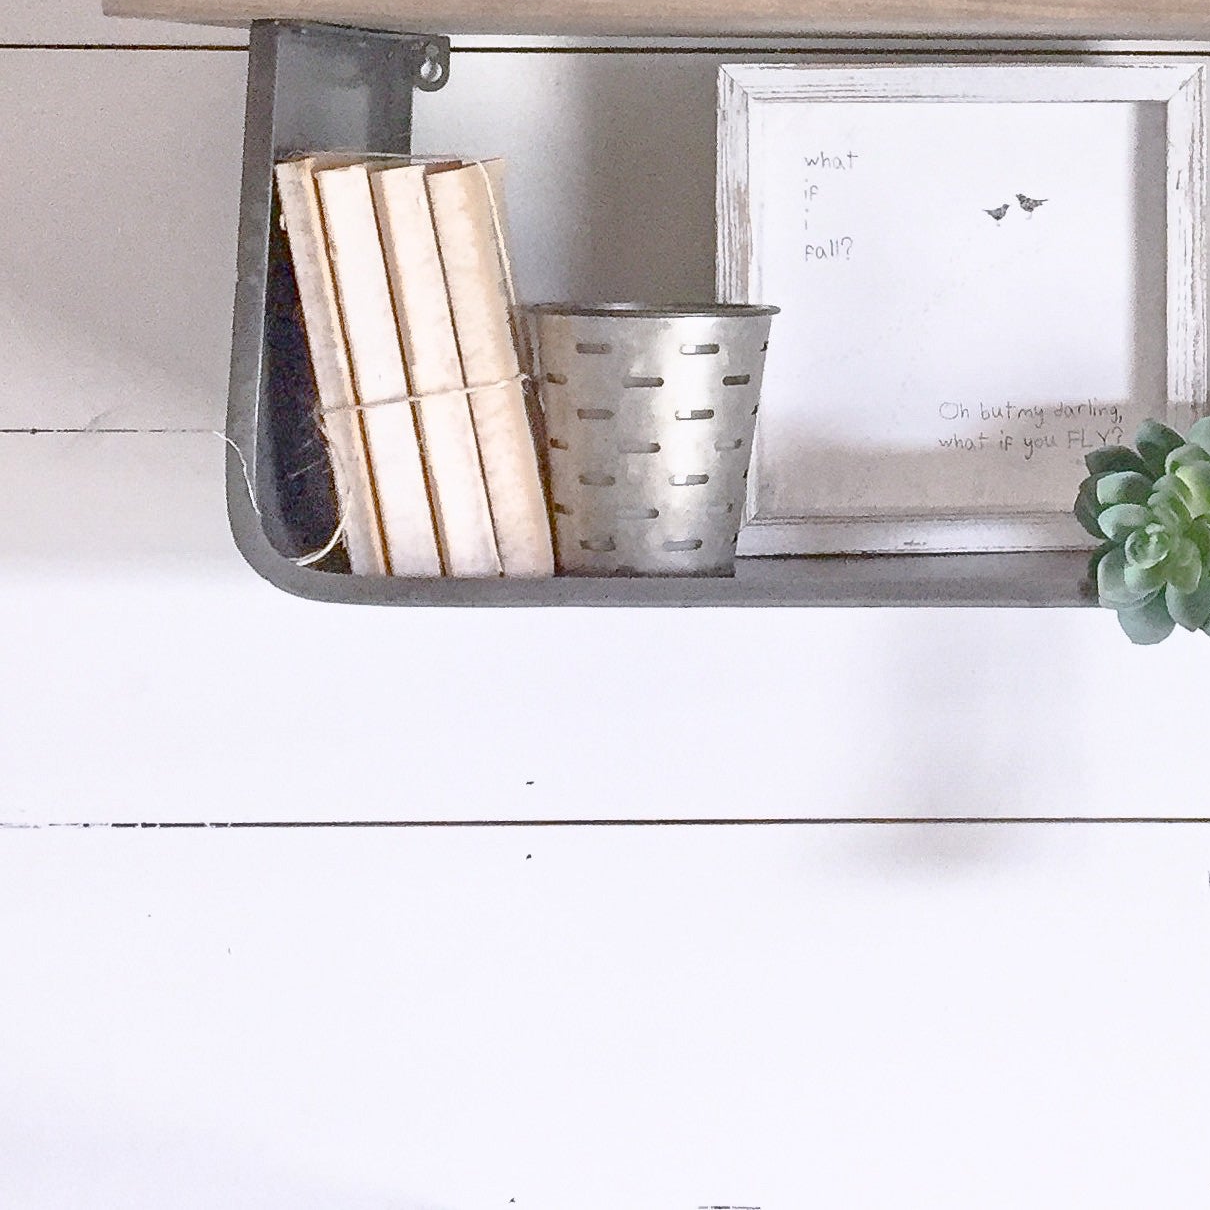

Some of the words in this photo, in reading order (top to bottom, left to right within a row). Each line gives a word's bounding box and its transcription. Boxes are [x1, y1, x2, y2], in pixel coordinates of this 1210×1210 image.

[804, 151, 858, 170] what
[804, 178, 819, 201] if
[804, 236, 853, 261] fall?
[939, 401, 970, 420] Oh
[979, 401, 1013, 421] but
[1017, 402, 1045, 428] my
[1053, 397, 1123, 423] darling,
[938, 432, 989, 451] what
[999, 430, 1013, 452] if
[1023, 433, 1058, 460] you
[1067, 425, 1124, 449] FLY?
